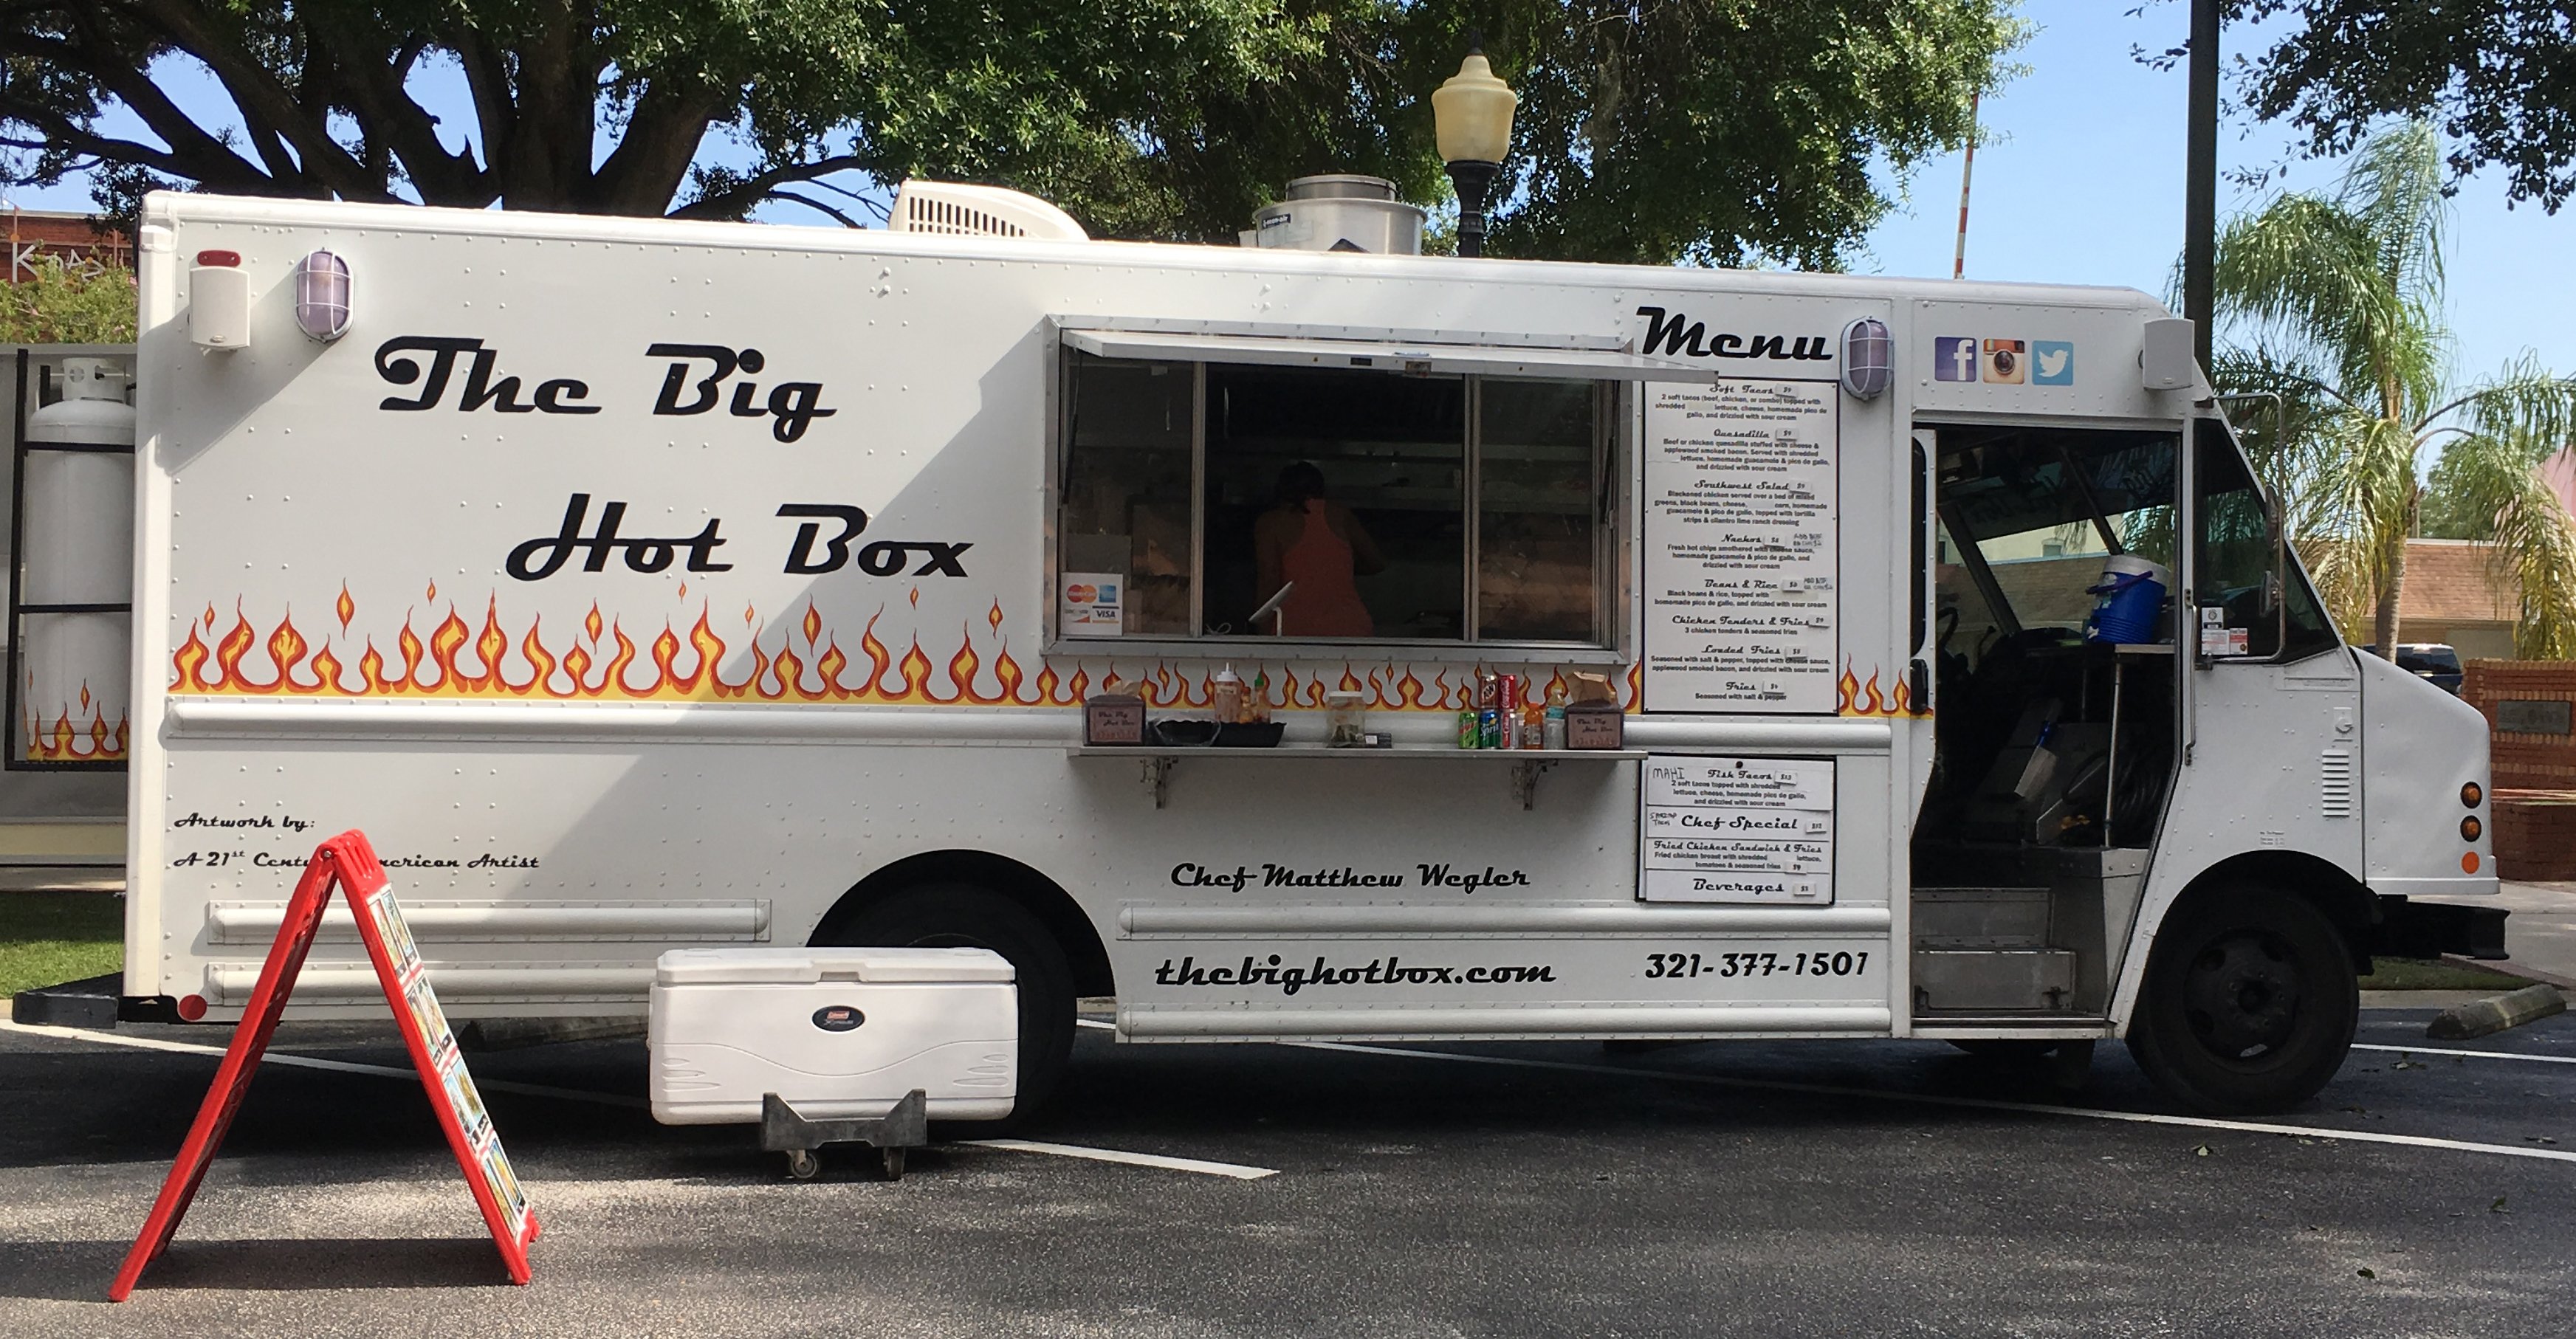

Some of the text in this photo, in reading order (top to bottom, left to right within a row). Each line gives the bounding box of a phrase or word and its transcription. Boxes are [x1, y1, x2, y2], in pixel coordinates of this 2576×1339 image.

[1636, 306, 1833, 360] Menu
[374, 335, 837, 444] The Big
[1709, 383, 1774, 395] Soft Tacos
[1714, 428, 1770, 438] Quesadilla
[1694, 480, 1790, 490] Southwest Salad
[506, 493, 974, 581] Hot Box
[1721, 534, 1762, 543] Nachos
[1704, 579, 1778, 590] Beans & Rice
[1672, 615, 1811, 627] Chicken Tenders & Fries
[1701, 644, 1781, 655] Loaded Fries
[1725, 681, 1756, 692] Fries
[1653, 767, 1685, 779] MAHI
[1707, 769, 1772, 780] Fish Tacos
[174, 812, 315, 833] Artwork by:
[1681, 814, 1798, 831] Chef Special
[1654, 840, 1822, 853] Fried Chicken Sandwich & Fries
[173, 852, 204, 867] A
[253, 852, 309, 867] Cent
[378, 855, 460, 867] merican
[467, 853, 540, 868] Artist
[1171, 863, 1531, 894] Chef Matthew Wegler
[1693, 878, 1785, 895] Beverages
[1645, 951, 1868, 978] 321-377-1501
[1155, 954, 1556, 996] thebighotbox.com
